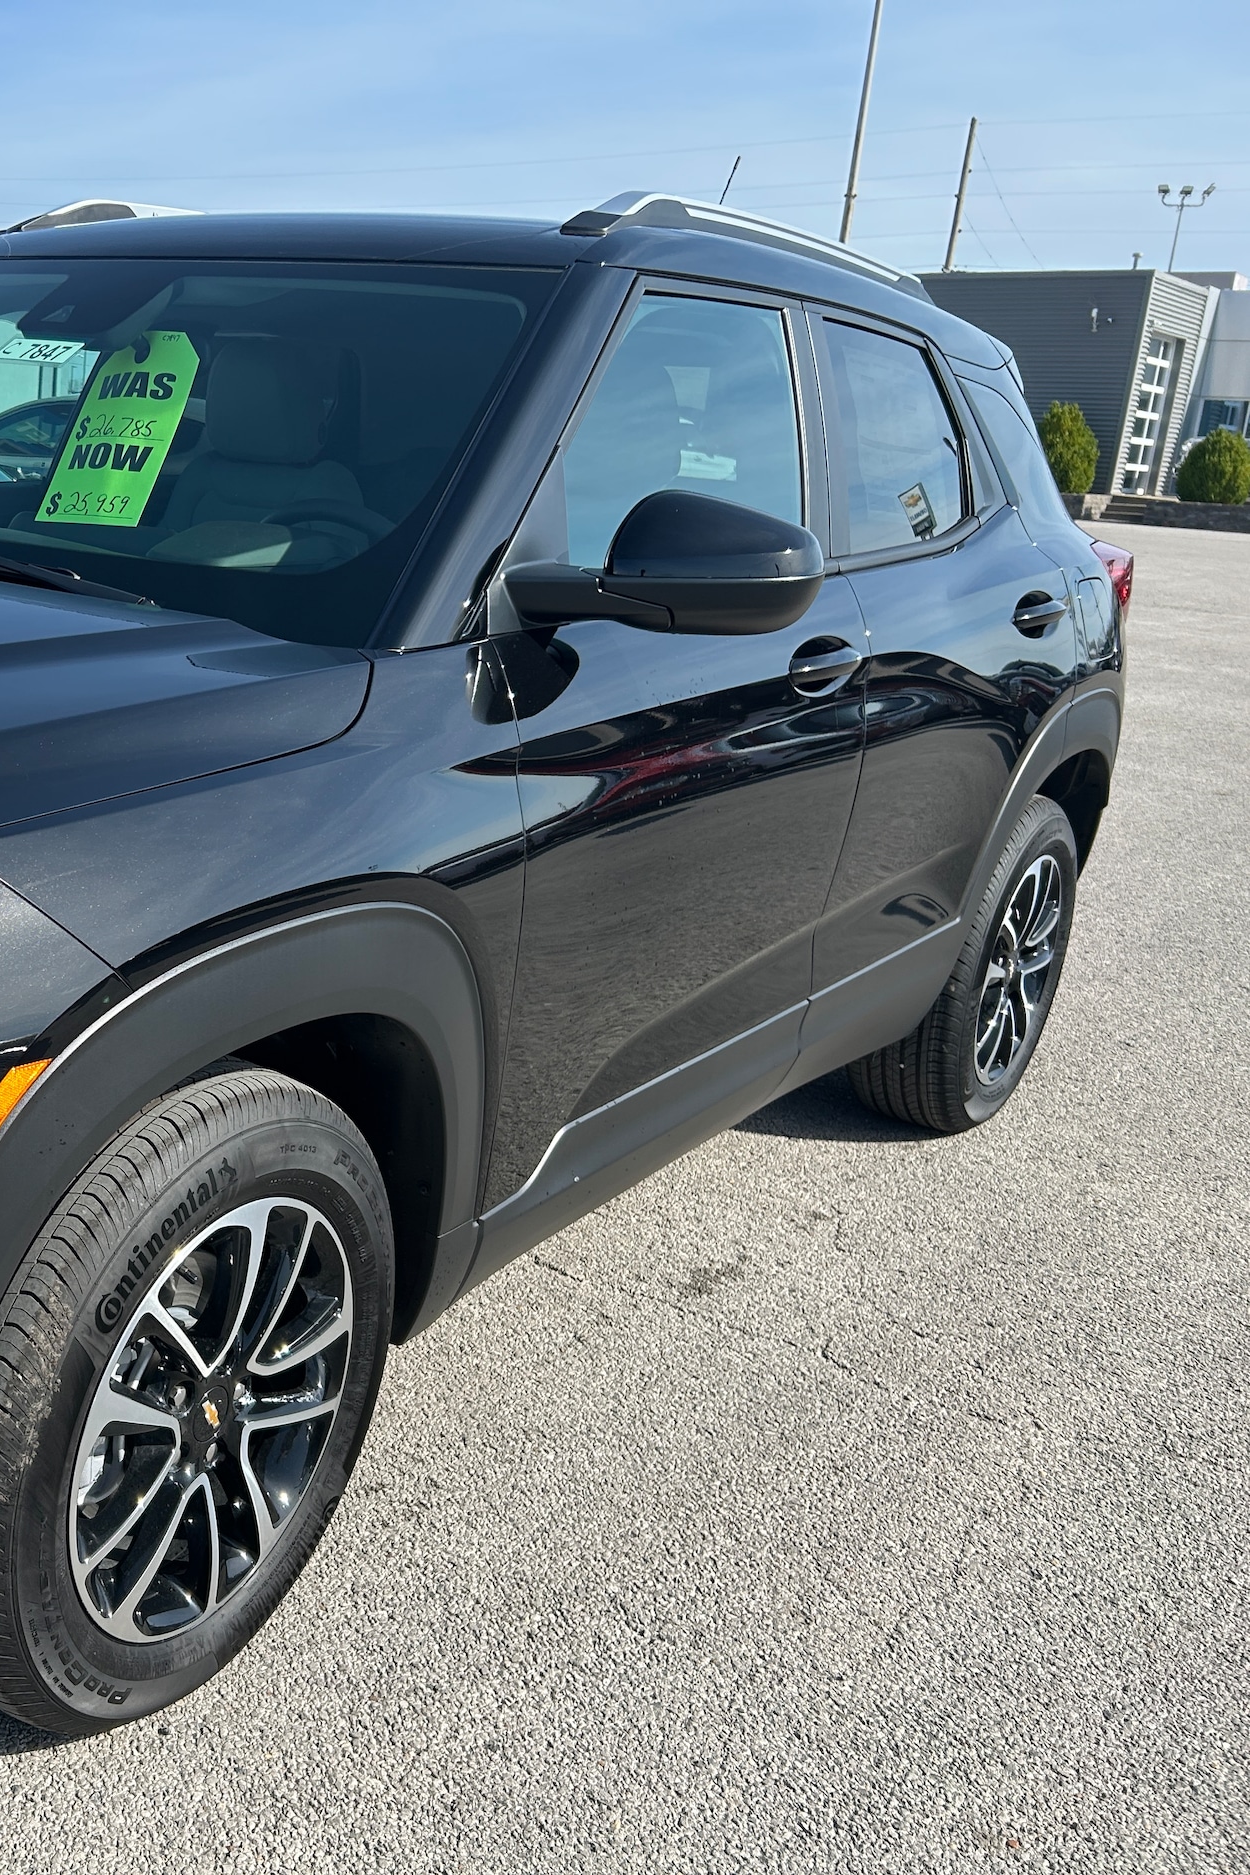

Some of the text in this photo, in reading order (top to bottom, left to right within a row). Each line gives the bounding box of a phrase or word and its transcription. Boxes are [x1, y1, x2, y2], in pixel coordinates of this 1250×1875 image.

[2, 342, 72, 360] C 7847
[98, 371, 177, 400] WAS
[68, 442, 154, 473] NOW
[298, 1145, 317, 1153] 4013
[95, 1168, 219, 1334] Continental
